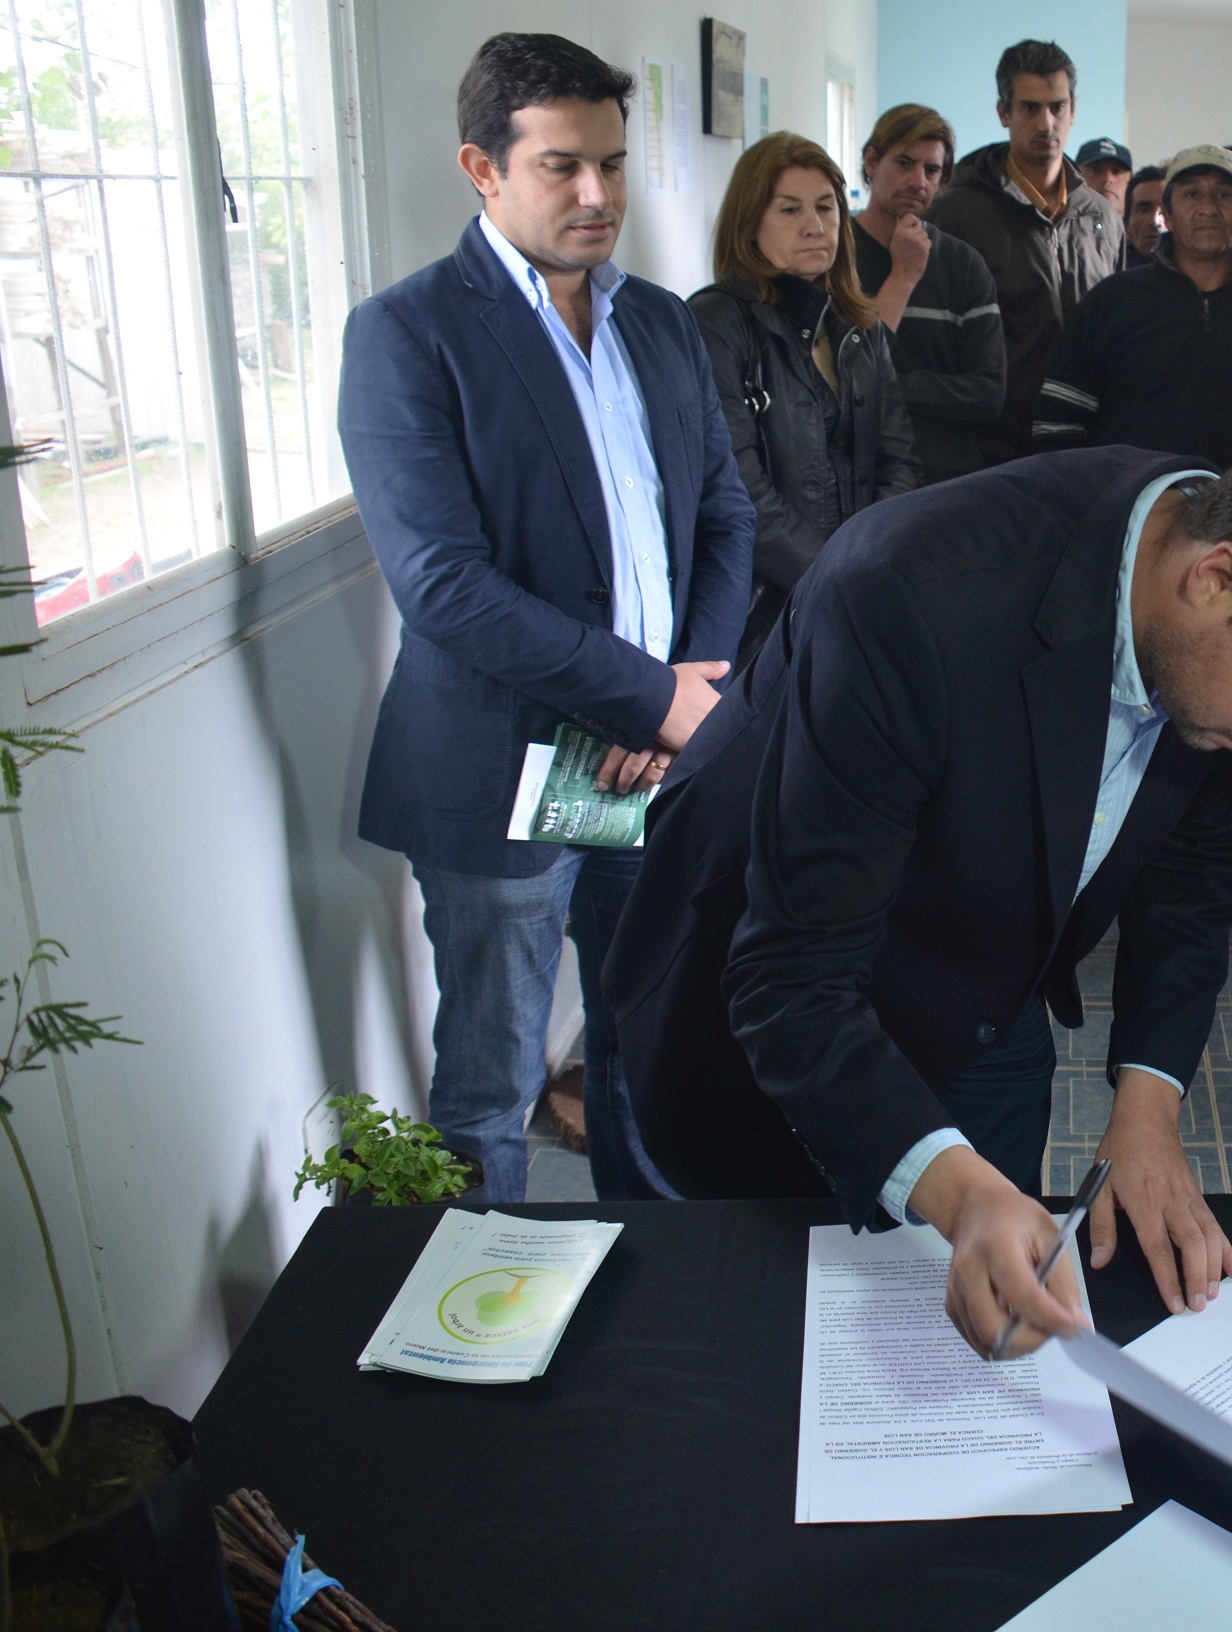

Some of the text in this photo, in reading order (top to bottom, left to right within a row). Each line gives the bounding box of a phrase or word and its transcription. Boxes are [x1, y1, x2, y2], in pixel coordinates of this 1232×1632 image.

[478, 1251, 513, 1259] sembrar,
[447, 1312, 464, 1330] árbol
[521, 1317, 539, 1328] una
[483, 1328, 518, 1338] estaca
[403, 1341, 427, 1349] Morro
[399, 1349, 447, 1364] Ambiental
[439, 1349, 470, 1357] Cuenca
[445, 1358, 499, 1367] Emergencia
